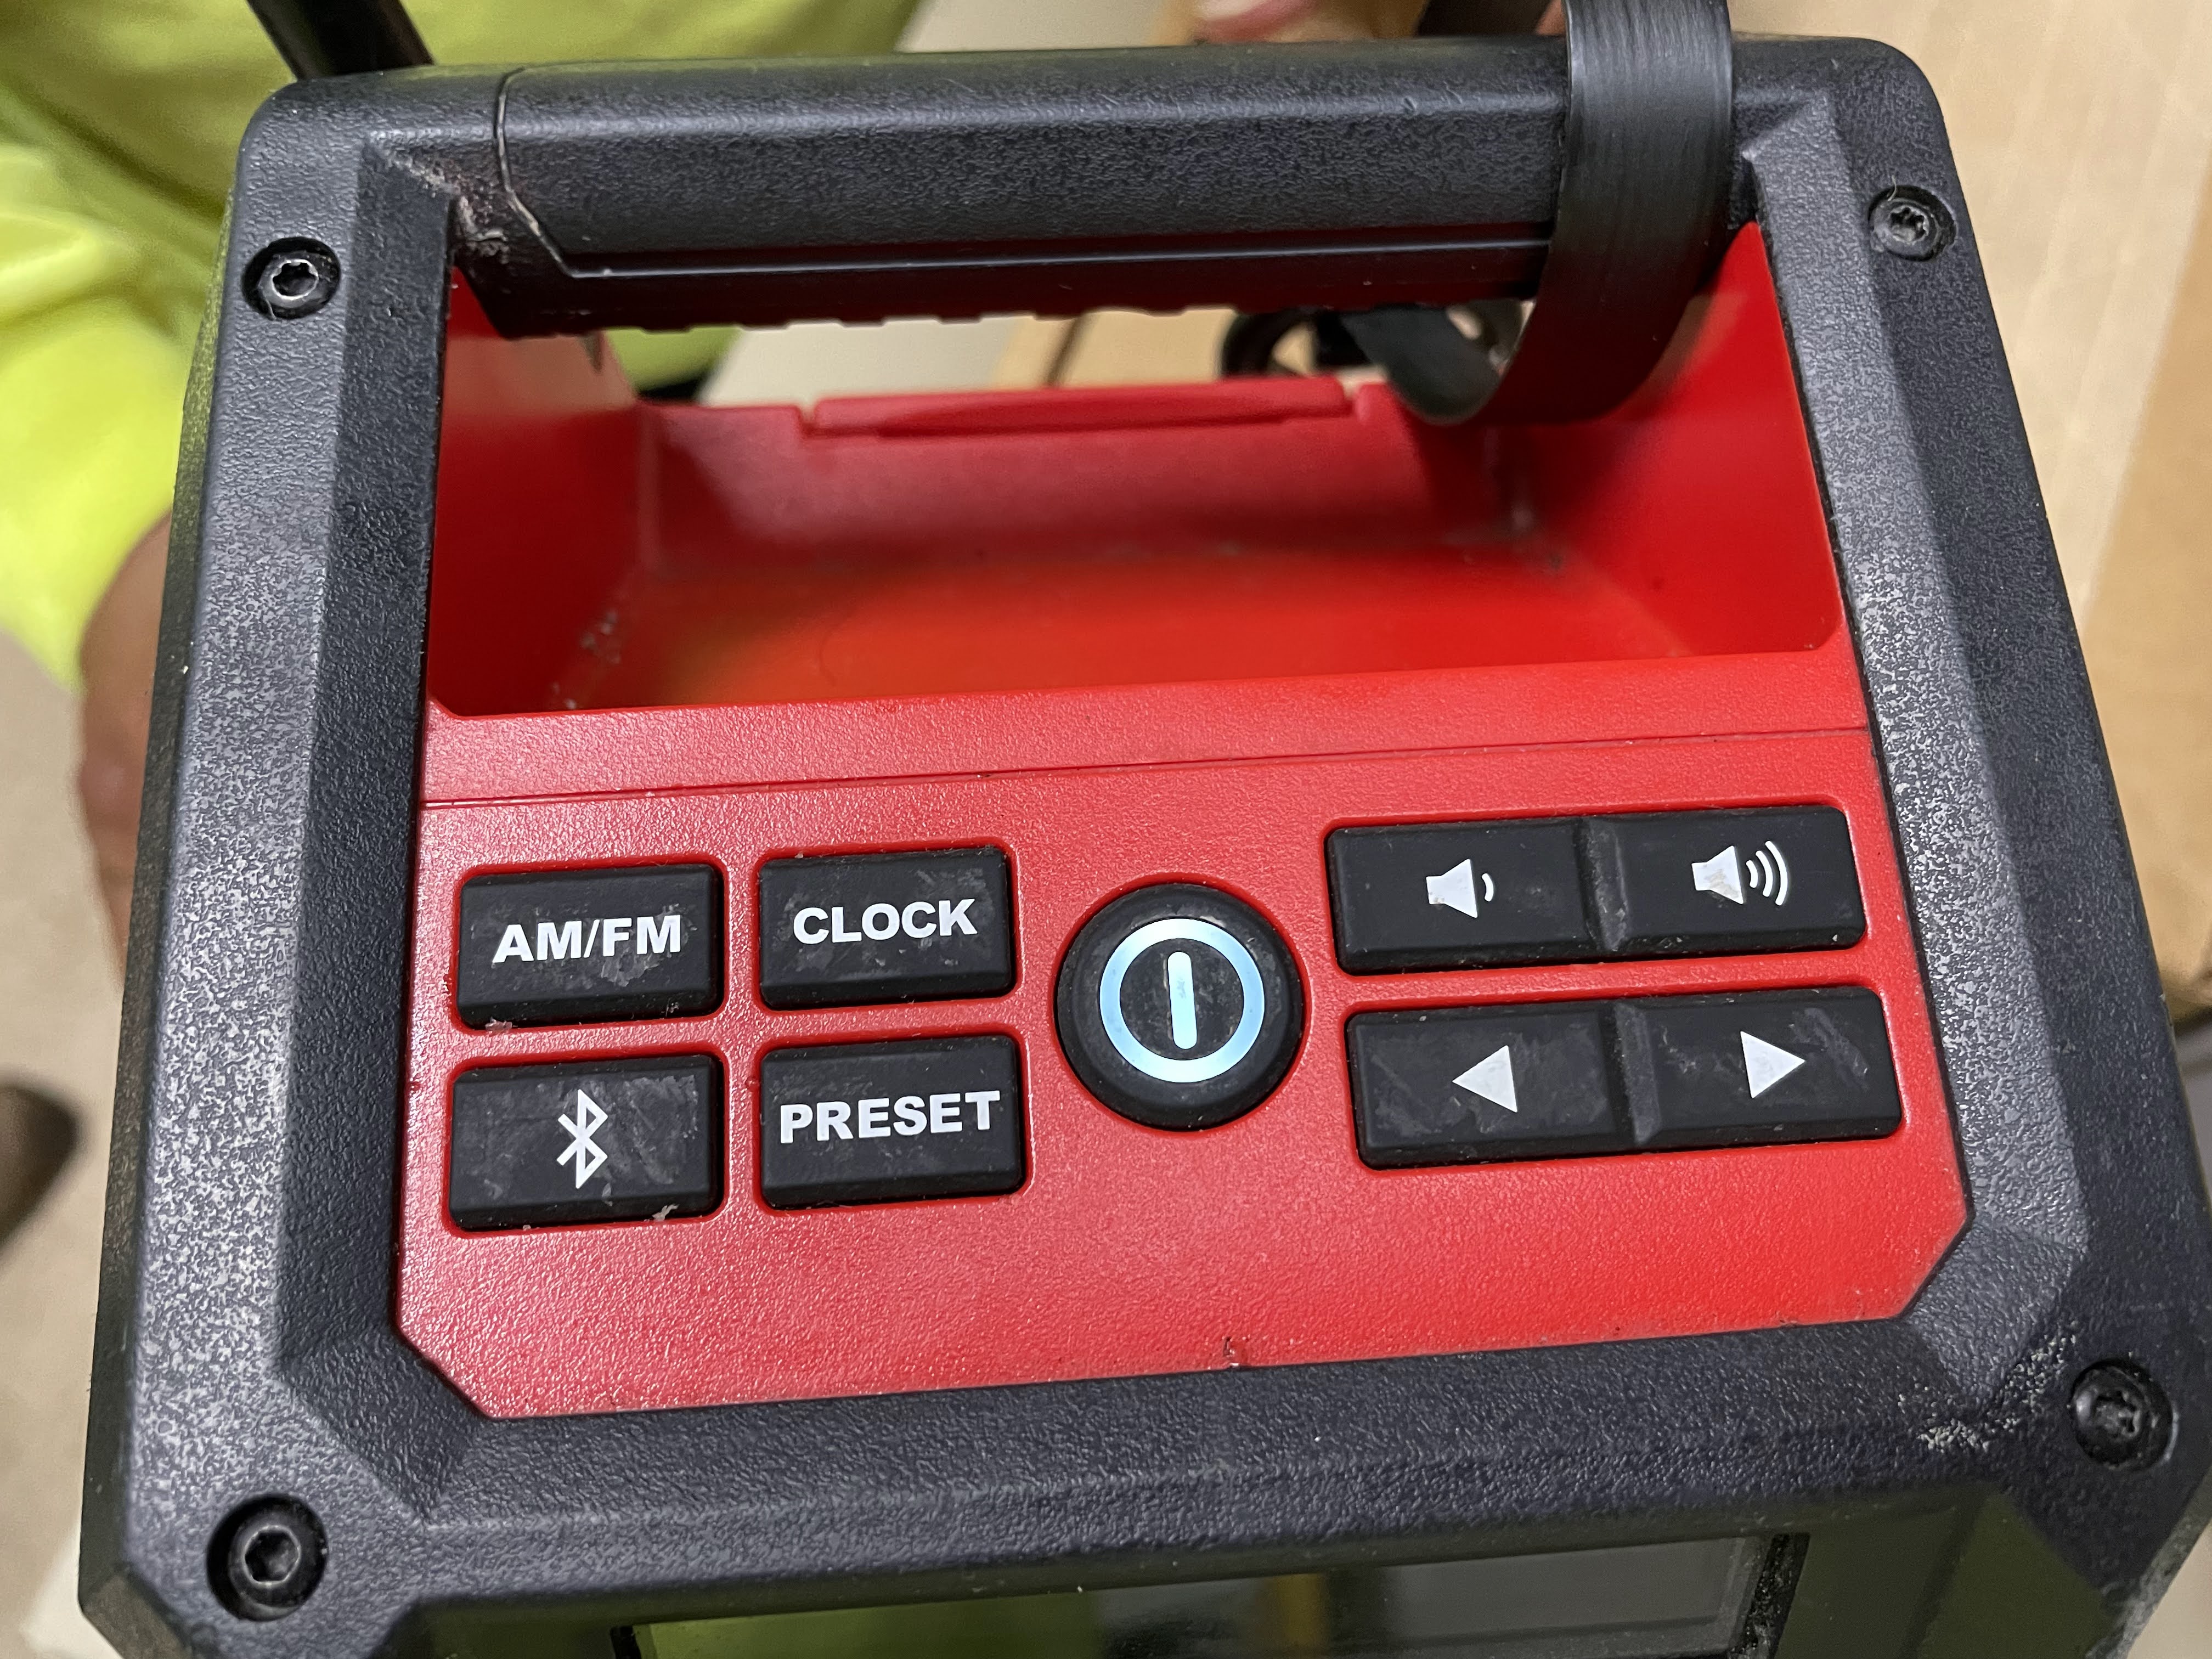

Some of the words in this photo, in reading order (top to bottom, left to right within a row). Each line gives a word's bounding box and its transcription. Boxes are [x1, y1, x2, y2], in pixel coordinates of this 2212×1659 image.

[492, 915, 681, 964] AM/FM
[793, 899, 978, 944] CLOCK
[780, 1090, 1000, 1144] PRESET
